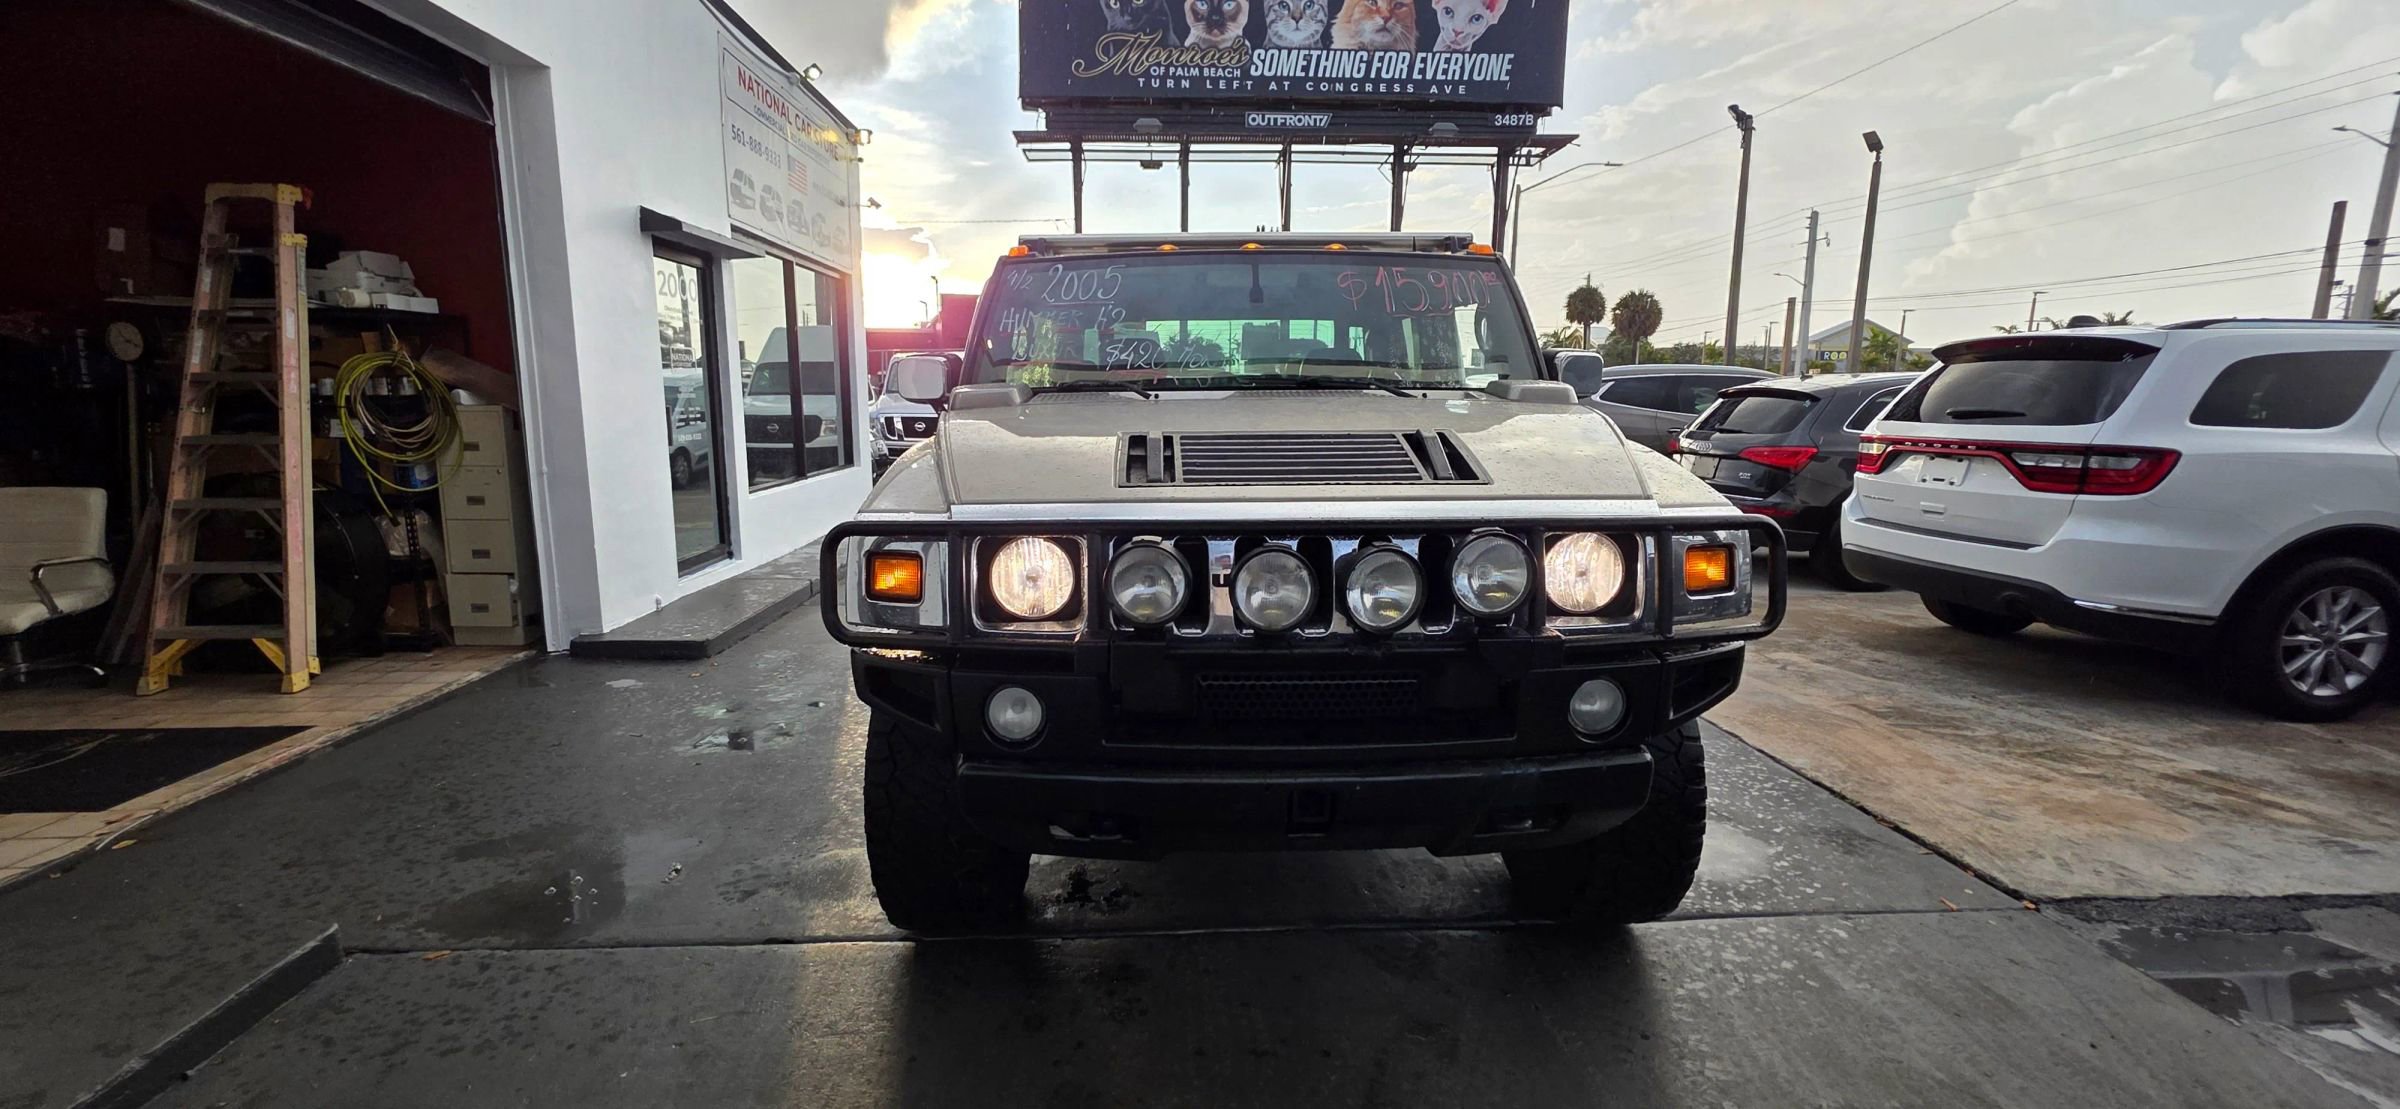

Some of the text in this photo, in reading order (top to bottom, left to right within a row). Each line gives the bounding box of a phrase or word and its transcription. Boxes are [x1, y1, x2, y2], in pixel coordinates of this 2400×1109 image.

[1072, 29, 1250, 78] Monroe's
[1250, 48, 1514, 81] SOMETHING FOR EVERYONE
[1138, 77, 1467, 95] TURN LEFT AT CONGRESS AVE
[1150, 66, 1241, 78] OF PALM BEACH
[736, 64, 793, 126] NATIONAL
[794, 113, 812, 137] CAR
[1494, 114, 1535, 126] 3487B
[1041, 264, 1127, 304] 2005
